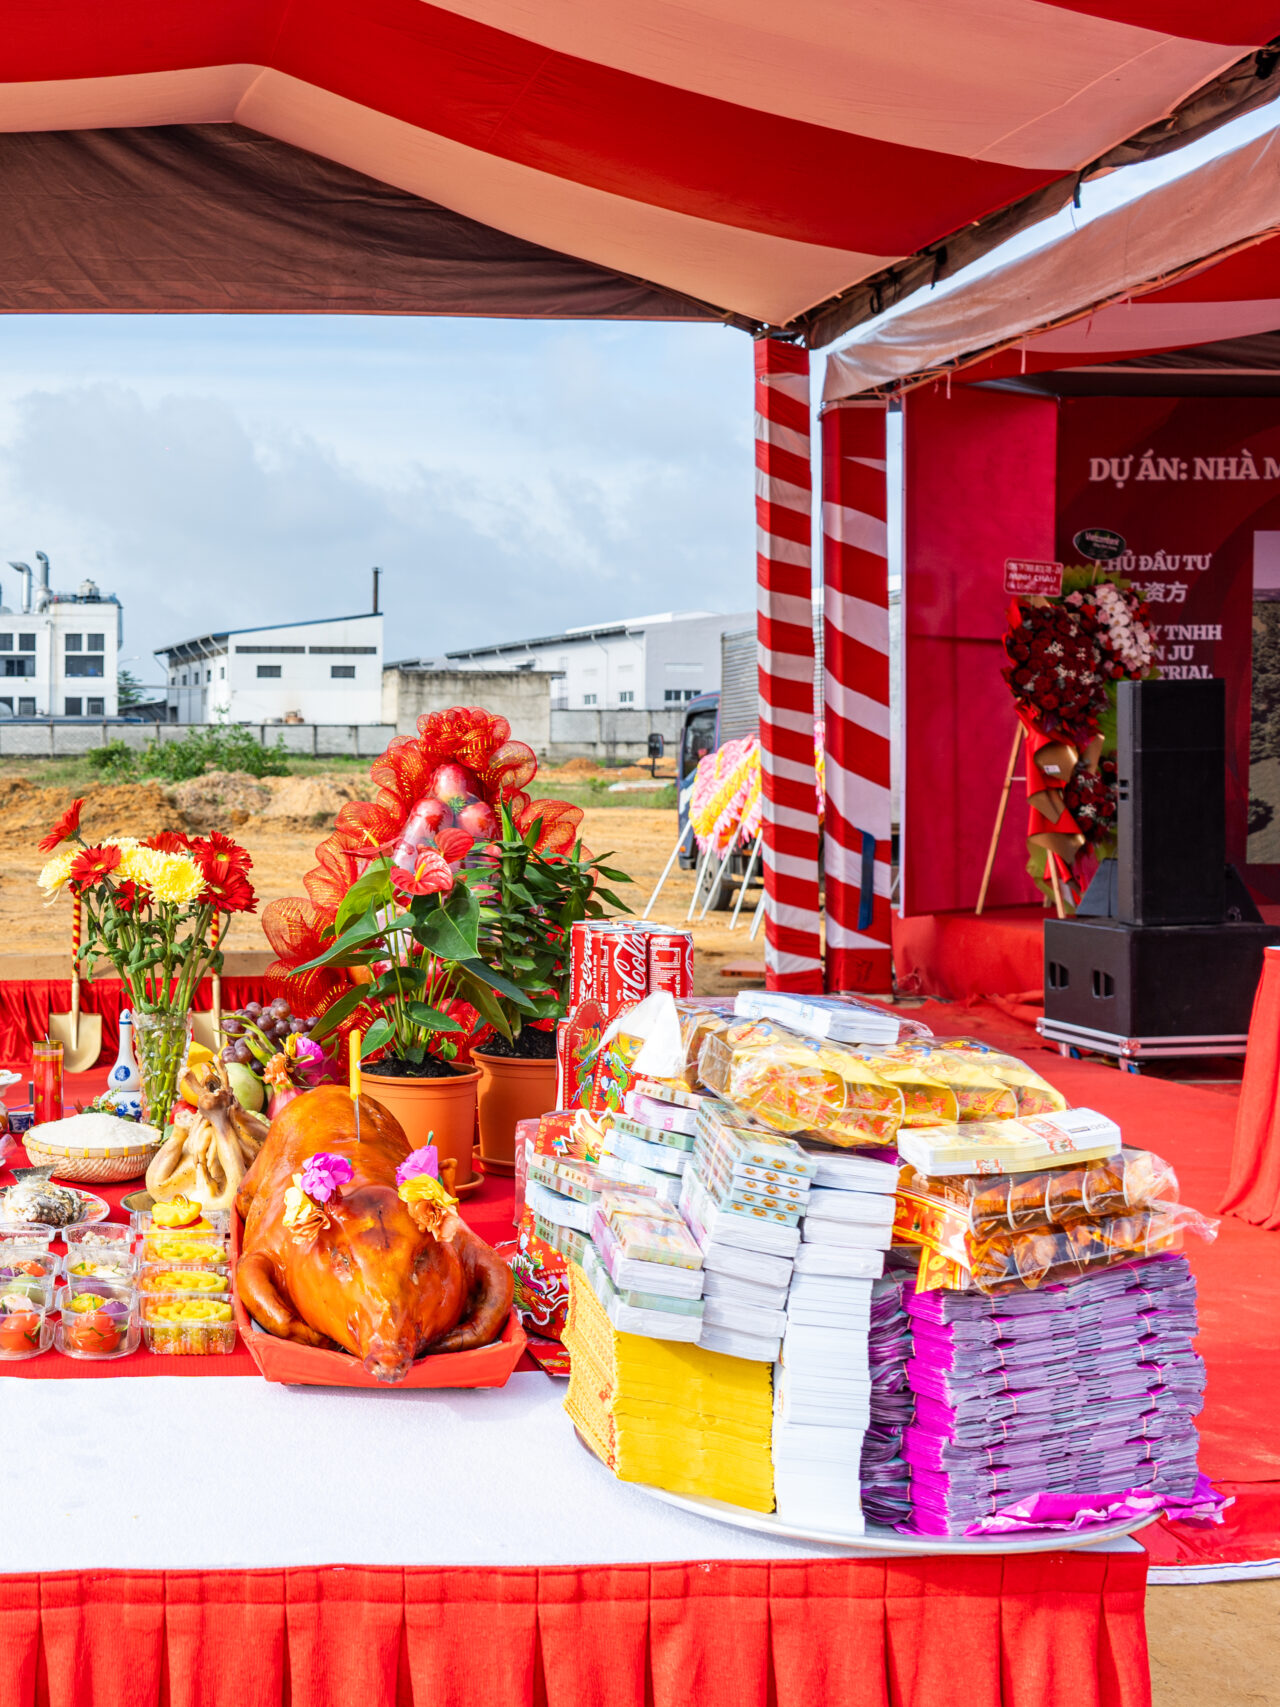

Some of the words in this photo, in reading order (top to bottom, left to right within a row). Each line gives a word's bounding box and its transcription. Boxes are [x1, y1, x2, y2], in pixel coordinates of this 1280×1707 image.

[1088, 454, 1134, 489] DỰ
[1135, 448, 1188, 481] ÁN:
[1193, 448, 1260, 480] NHÀ
[1103, 549, 1136, 571] HỦ
[1138, 549, 1180, 571] ĐẦU
[1182, 552, 1213, 571] TƯ
[1164, 624, 1223, 640] TNHH
[1167, 645, 1195, 661] JU
